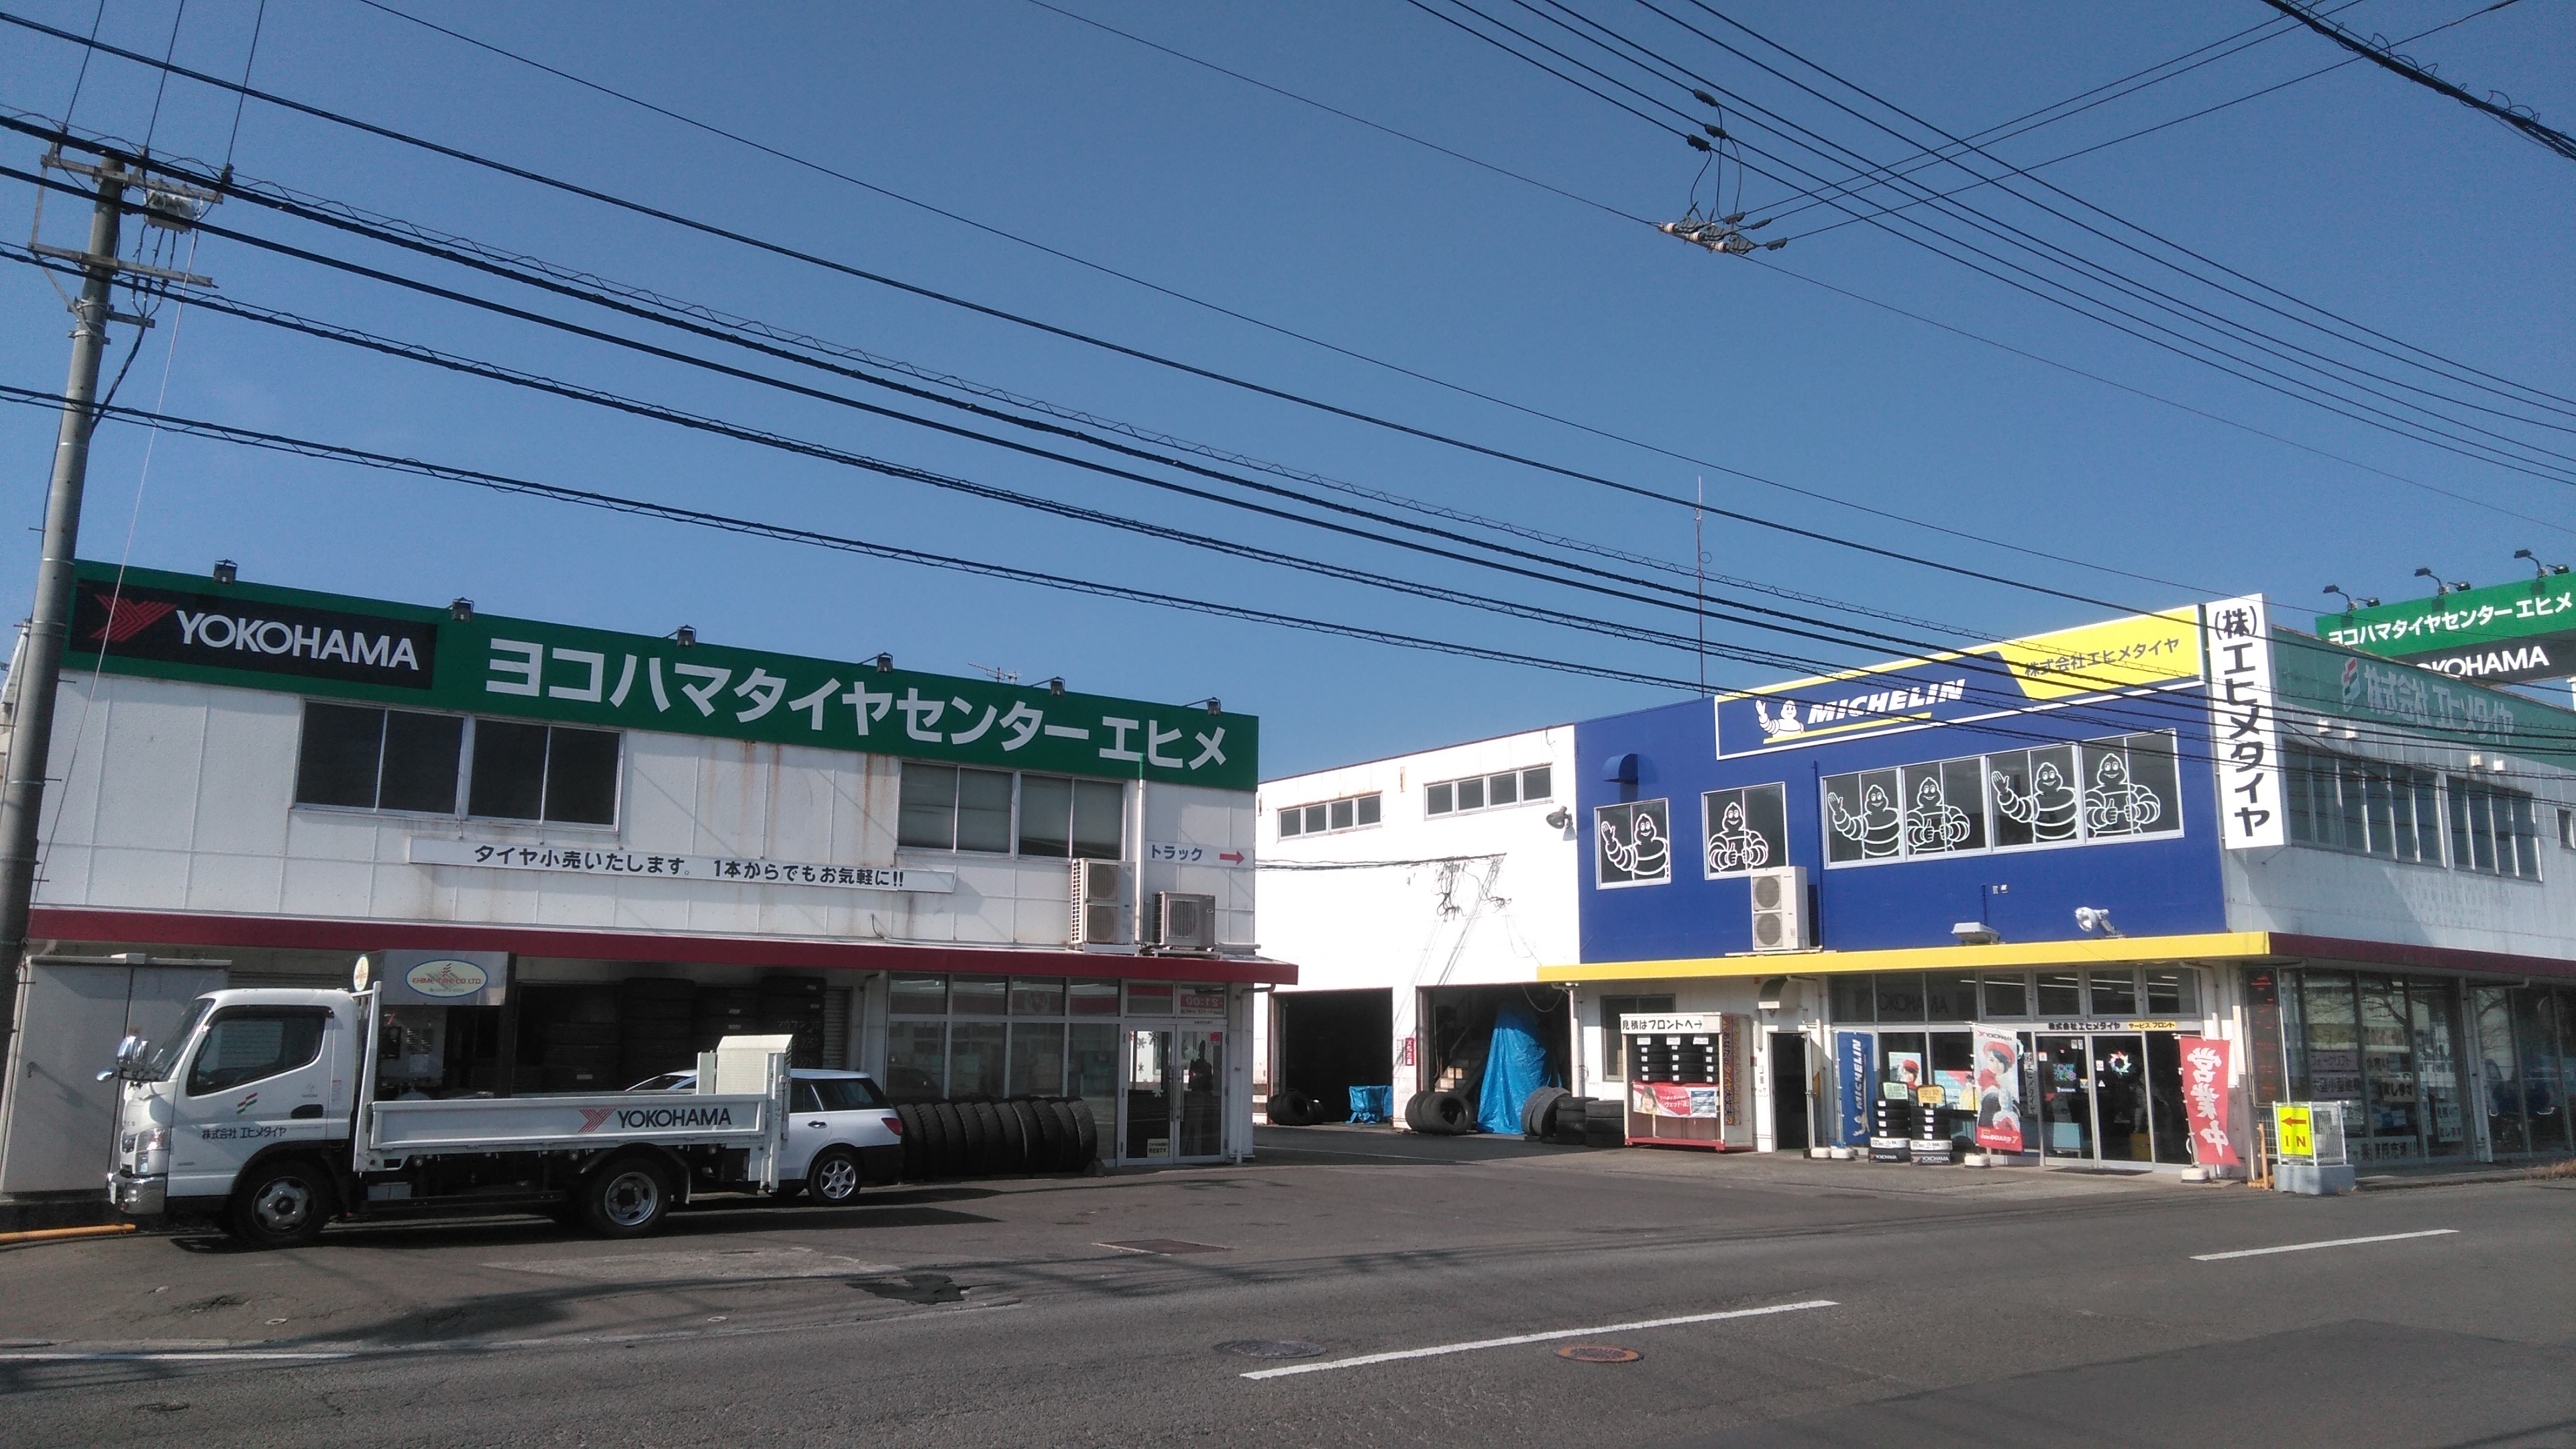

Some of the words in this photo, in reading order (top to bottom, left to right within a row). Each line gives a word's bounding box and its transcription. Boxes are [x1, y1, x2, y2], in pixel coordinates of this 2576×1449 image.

[176, 610, 419, 671] YOKOHAMA
[486, 638, 1227, 770] ヨコハマタイヤセンターエヒメ
[1807, 679, 1967, 724] MICHELIN
[474, 845, 690, 876] タイヤ小売いたします。
[1151, 844, 1203, 861] トラック
[1986, 1033, 2012, 1041] YOKOHAMA
[1852, 1039, 1864, 1110] MICHELIN
[2188, 1047, 2229, 1157] 営業中
[240, 1126, 286, 1139] エヒメタイヤ
[616, 1108, 732, 1128] YOKOHAMA
[2285, 1135, 2306, 1148] IN
